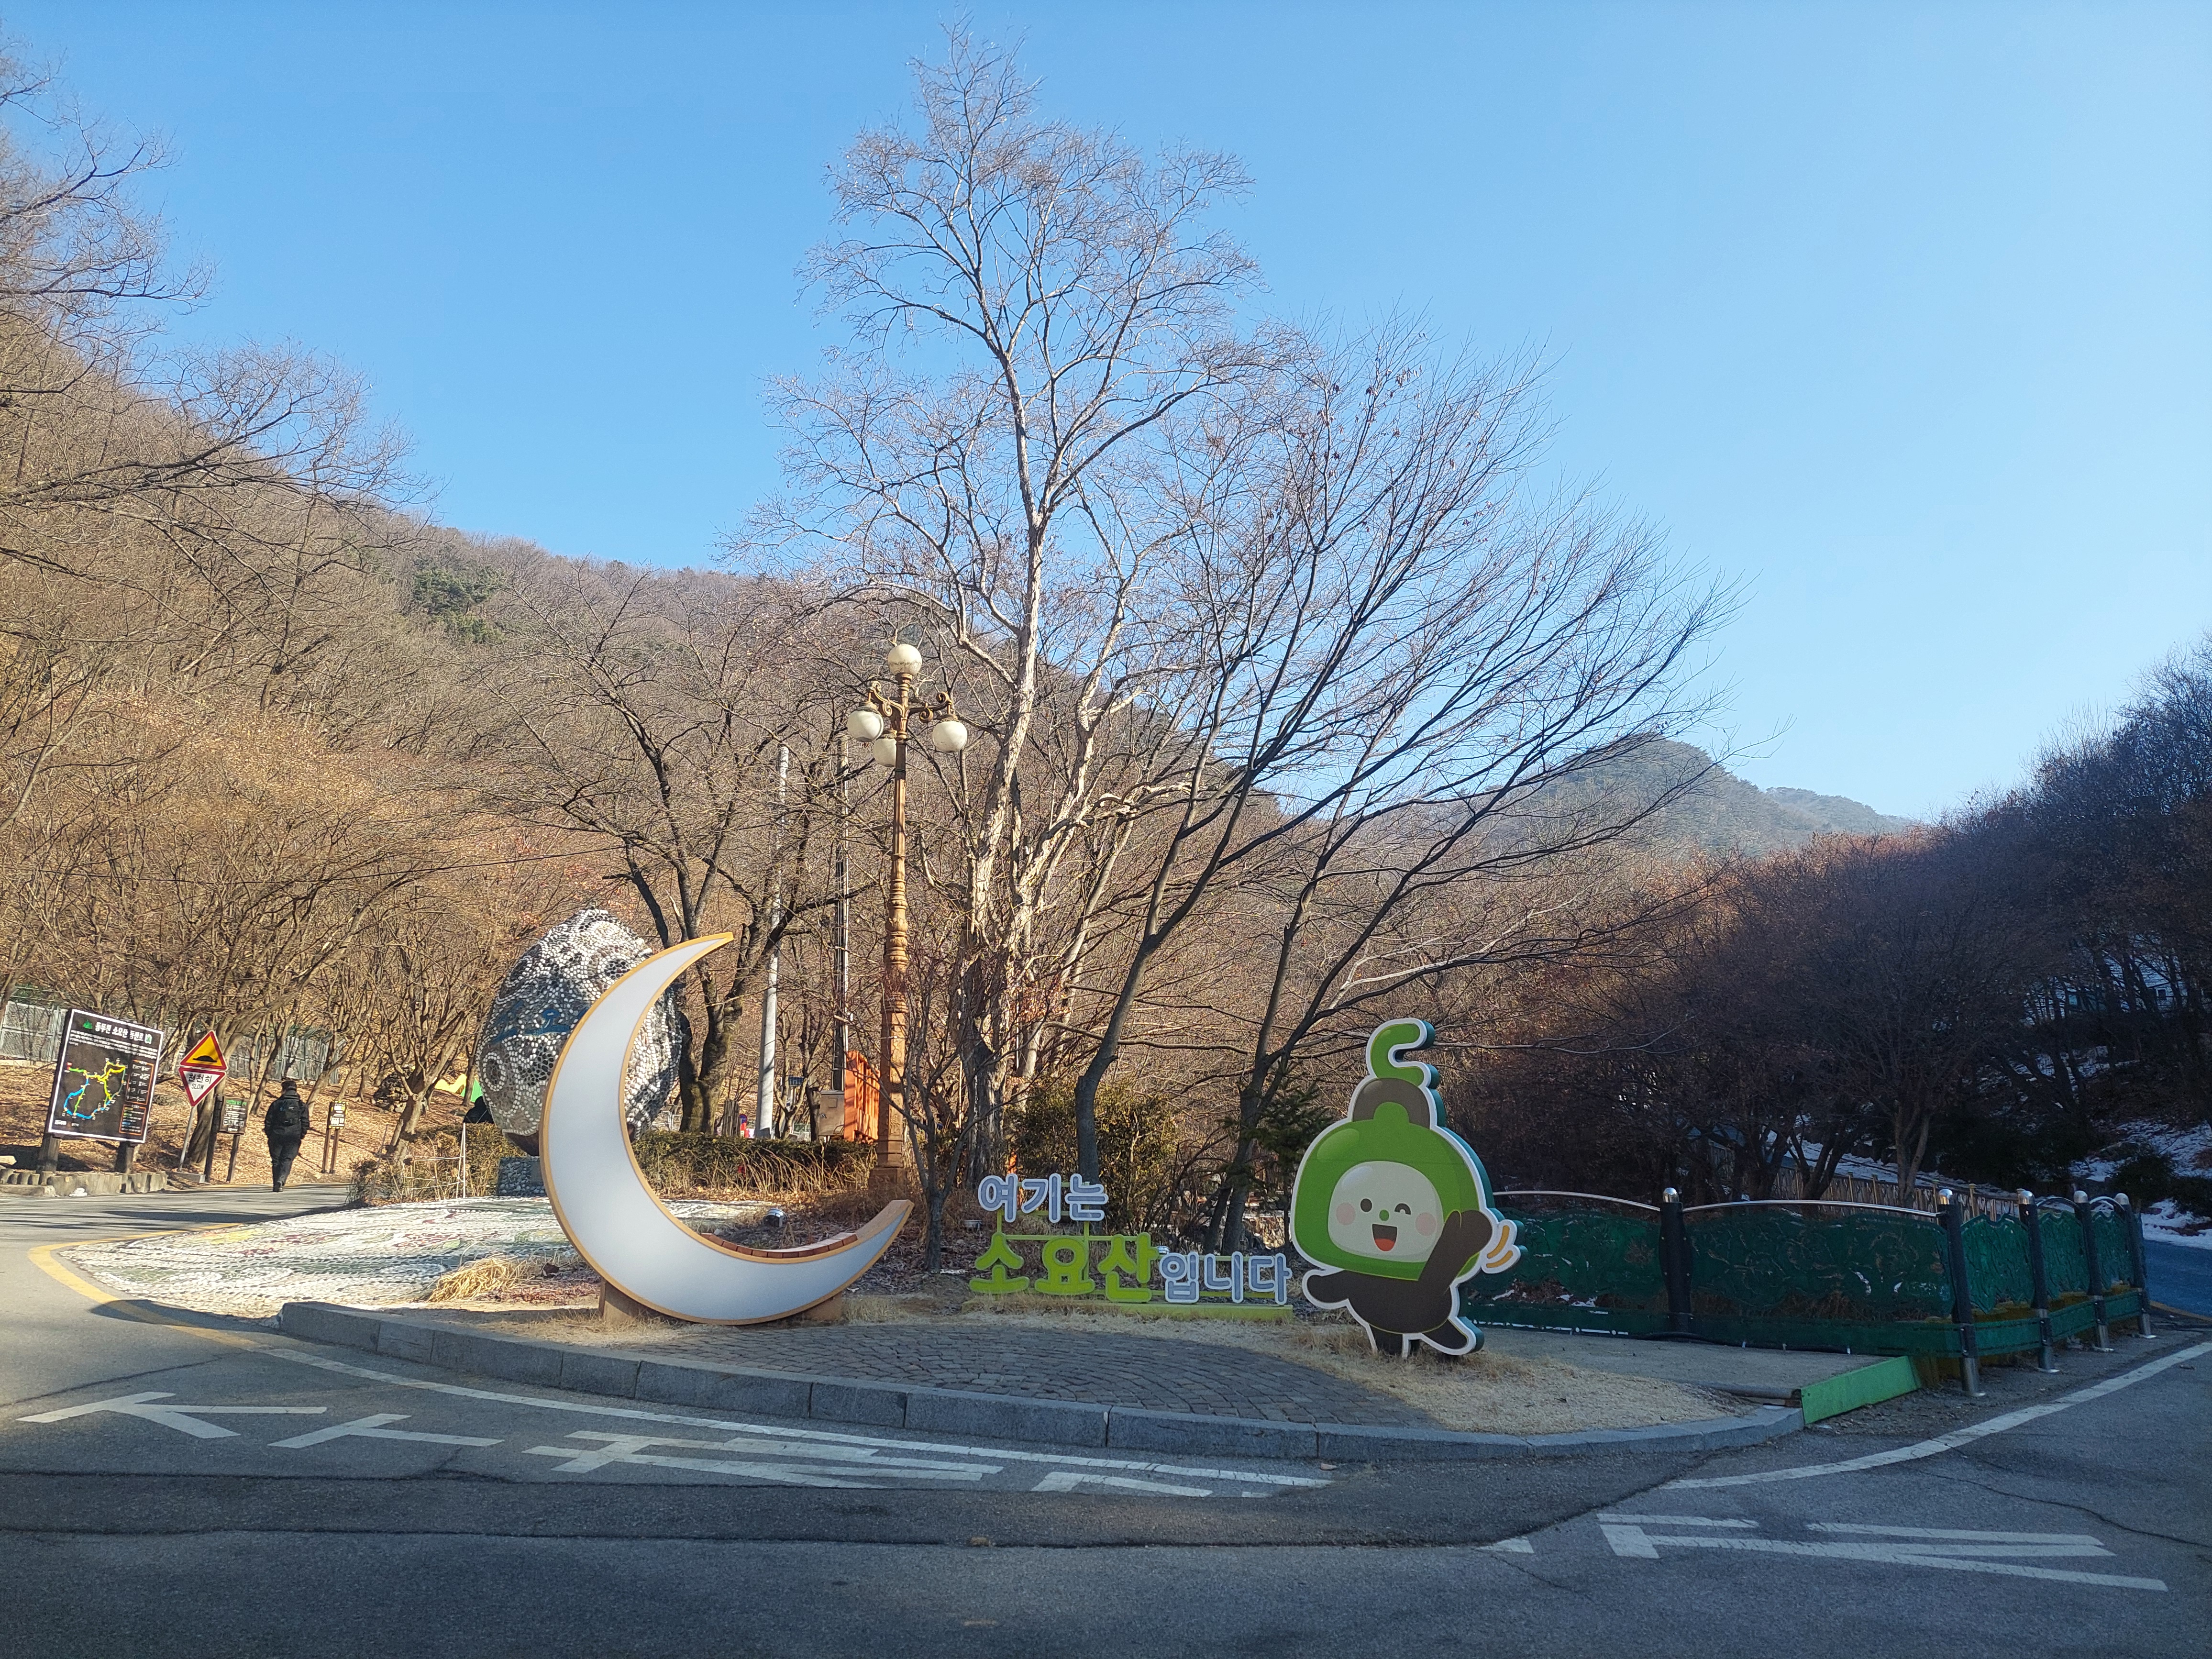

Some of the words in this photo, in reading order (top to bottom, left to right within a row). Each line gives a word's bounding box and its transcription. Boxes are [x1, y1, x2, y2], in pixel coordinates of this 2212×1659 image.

[95, 1022, 111, 1034] 동두천
[111, 1026, 128, 1039] 소요산
[129, 1030, 144, 1041] 등산로
[188, 1073, 212, 1084] 천천히
[978, 1173, 1109, 1223] 여기는
